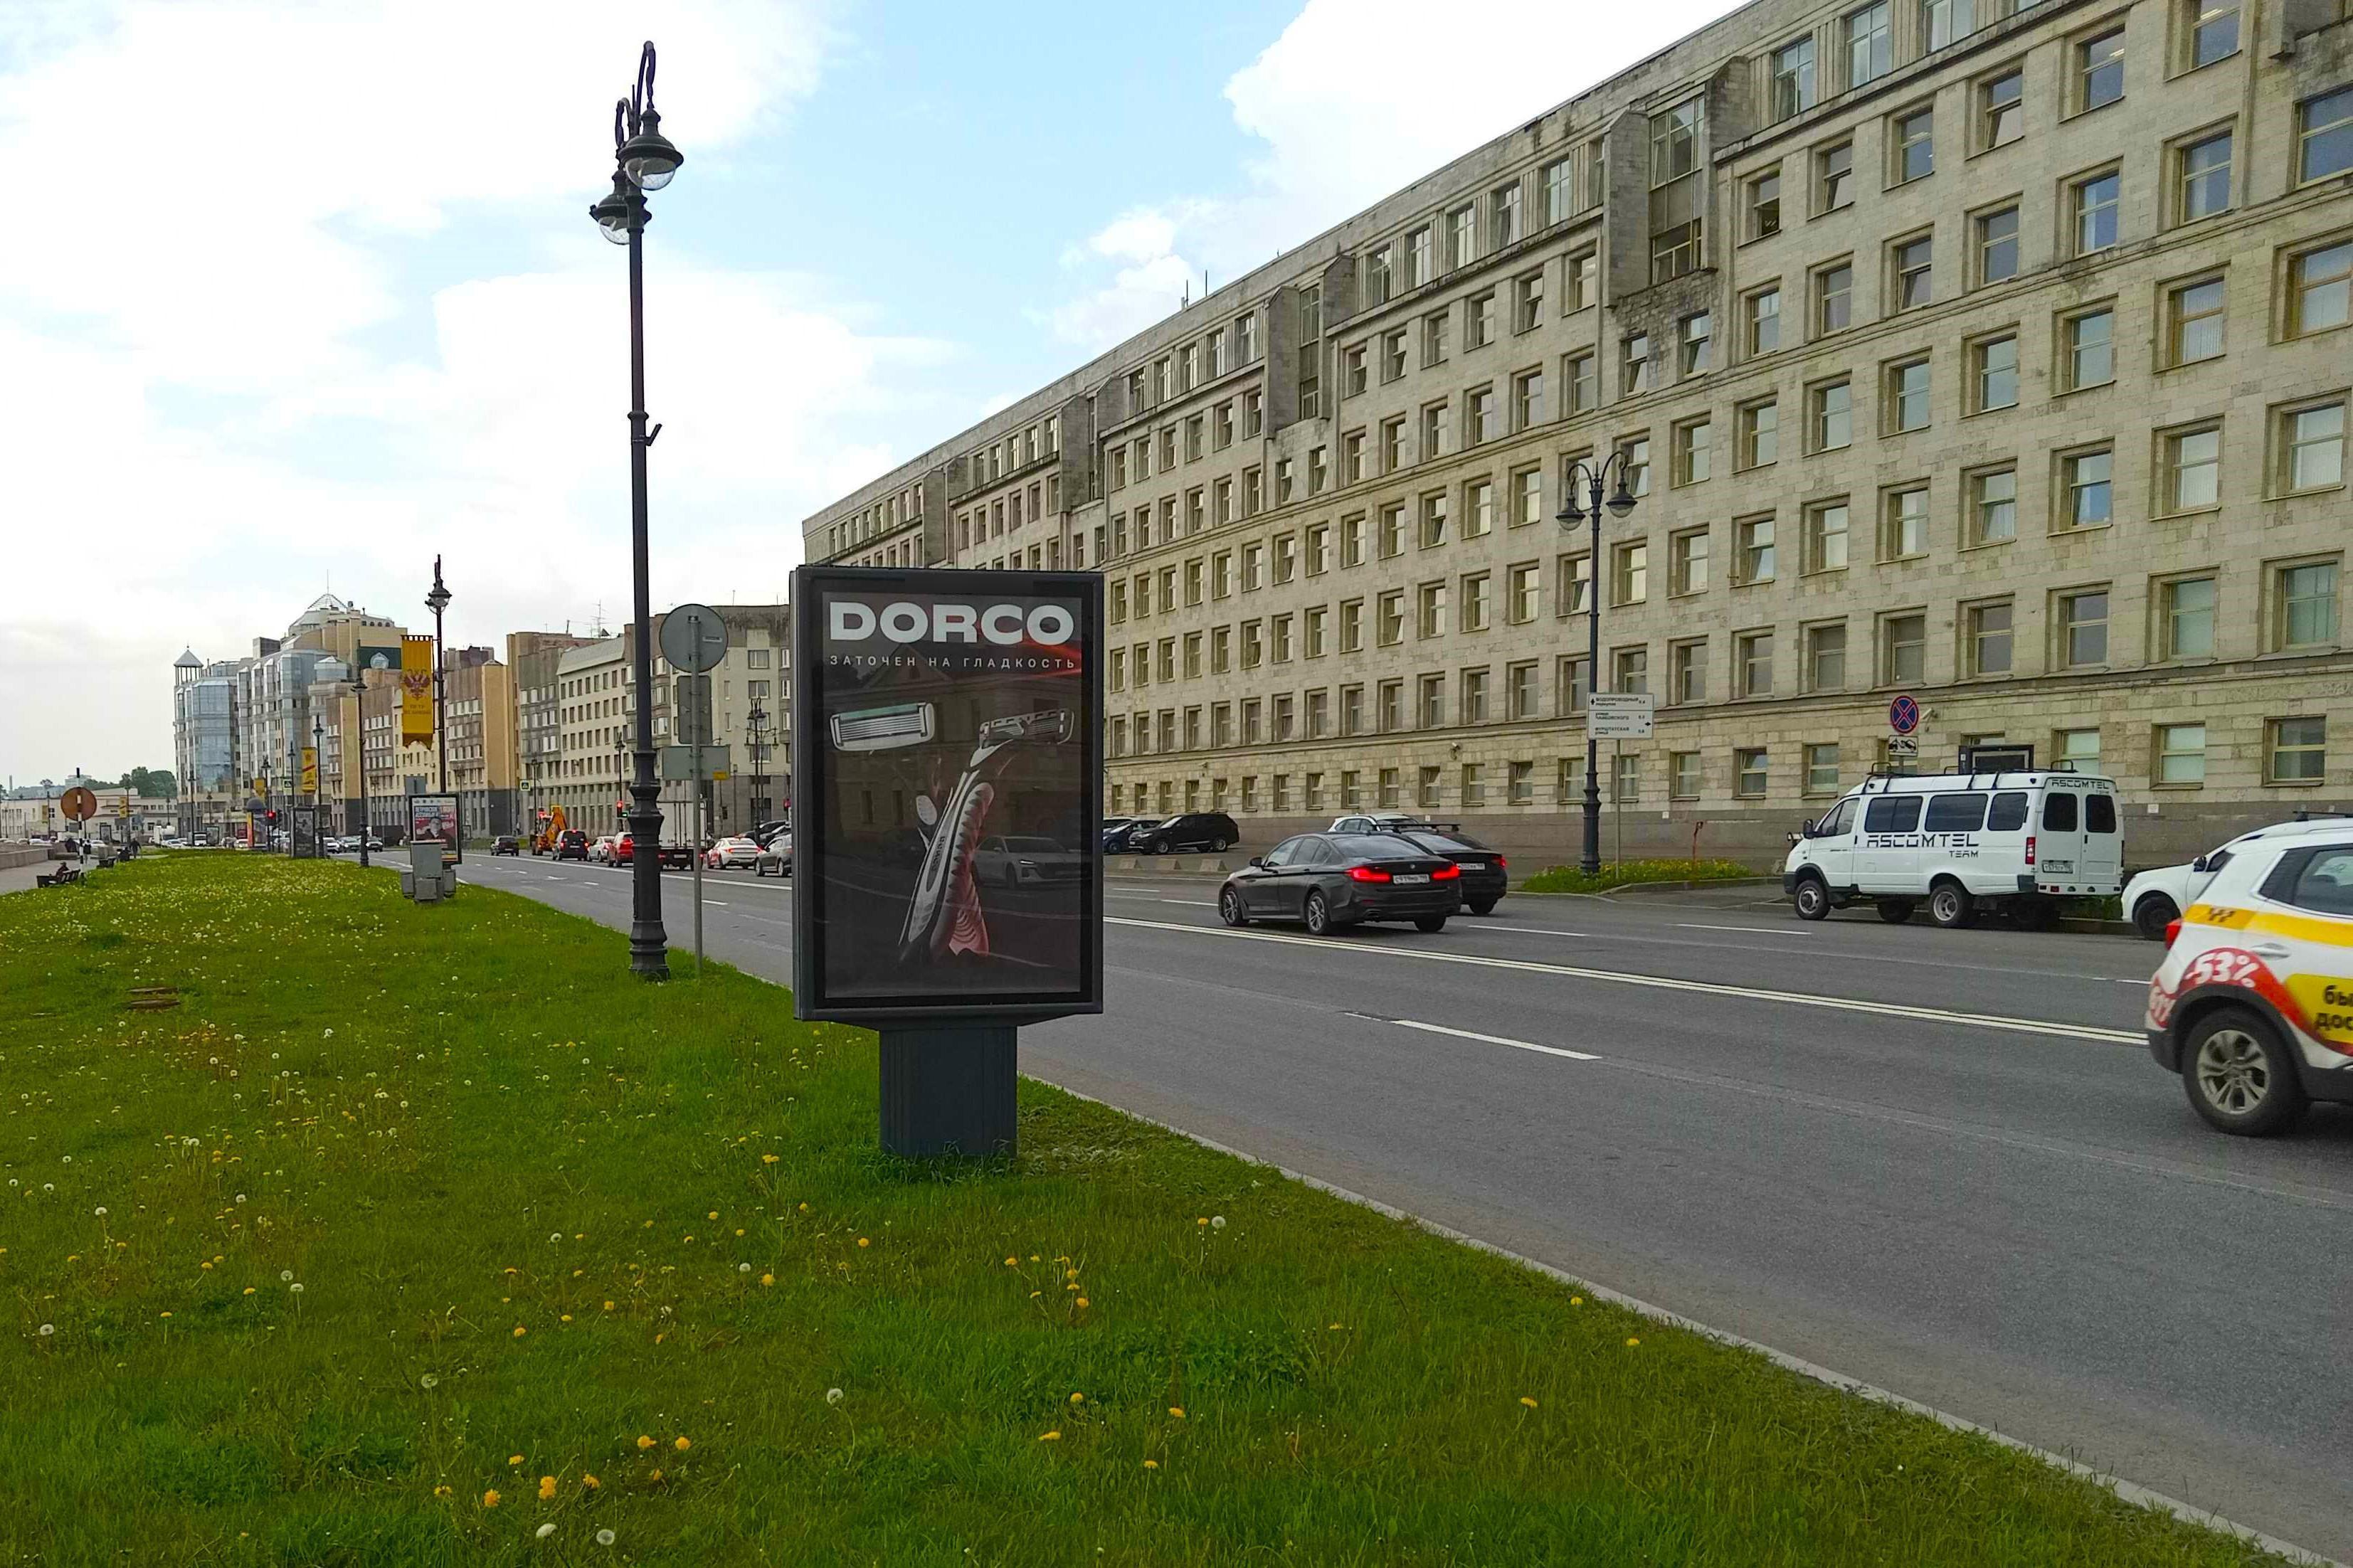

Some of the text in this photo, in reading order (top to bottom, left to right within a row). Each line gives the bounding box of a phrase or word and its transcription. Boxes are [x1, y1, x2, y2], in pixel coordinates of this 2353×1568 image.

[830, 602, 1074, 645] DORCO
[830, 655, 1074, 669] ЗАТОЧЕН НА ГЛАДКОСТЬ
[2051, 779, 2109, 790] ASCOMTEL
[1867, 834, 1979, 847] ASCOMTEL
